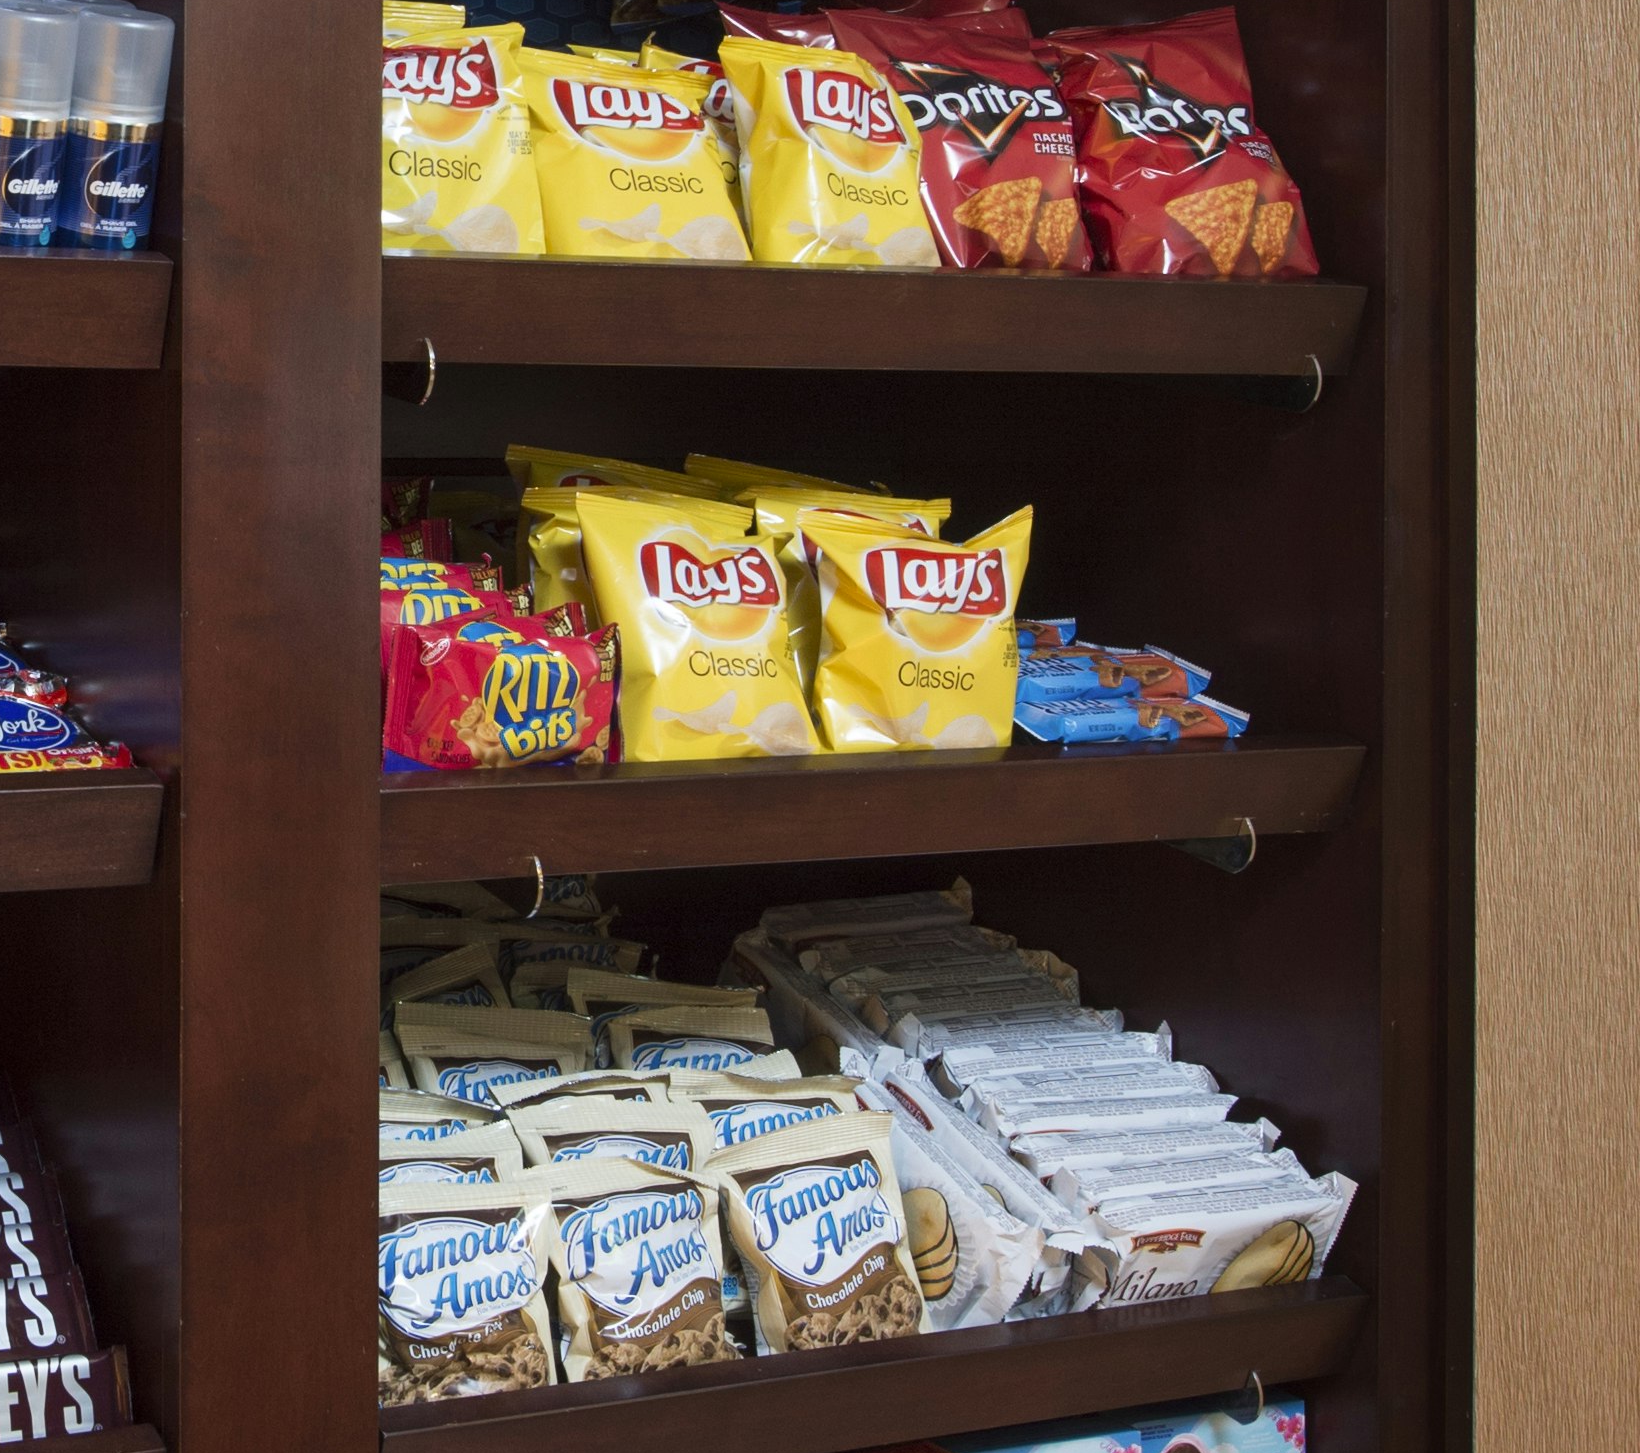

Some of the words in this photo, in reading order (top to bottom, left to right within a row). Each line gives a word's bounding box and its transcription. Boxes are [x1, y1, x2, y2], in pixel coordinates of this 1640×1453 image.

[800, 69, 896, 140] Lay's
[899, 83, 1064, 128] Doritos
[1033, 133, 1073, 144] NACHO
[7, 178, 59, 195] Gillette
[89, 180, 147, 197] Gillette
[388, 150, 482, 182] Classic
[610, 168, 704, 194] Classic
[826, 172, 909, 207] Classic
[655, 544, 766, 608] Lay's
[881, 549, 999, 613] Lay's
[486, 653, 570, 723] RITZ
[688, 650, 778, 678] Classic
[898, 660, 975, 692] Classic
[503, 712, 573, 758] bits
[746, 1159, 879, 1252] Famous
[380, 1218, 526, 1298] Famous
[561, 1189, 704, 1282] Famous
[803, 1201, 888, 1276] Amos
[614, 1231, 706, 1305] Amos
[806, 1273, 864, 1310] Chocolate
[862, 1254, 886, 1277] Chip
[1110, 1267, 1198, 1301] Milano
[411, 1264, 538, 1329] Amos
[615, 1304, 681, 1340] Chocolate
[681, 1288, 705, 1312] Chip
